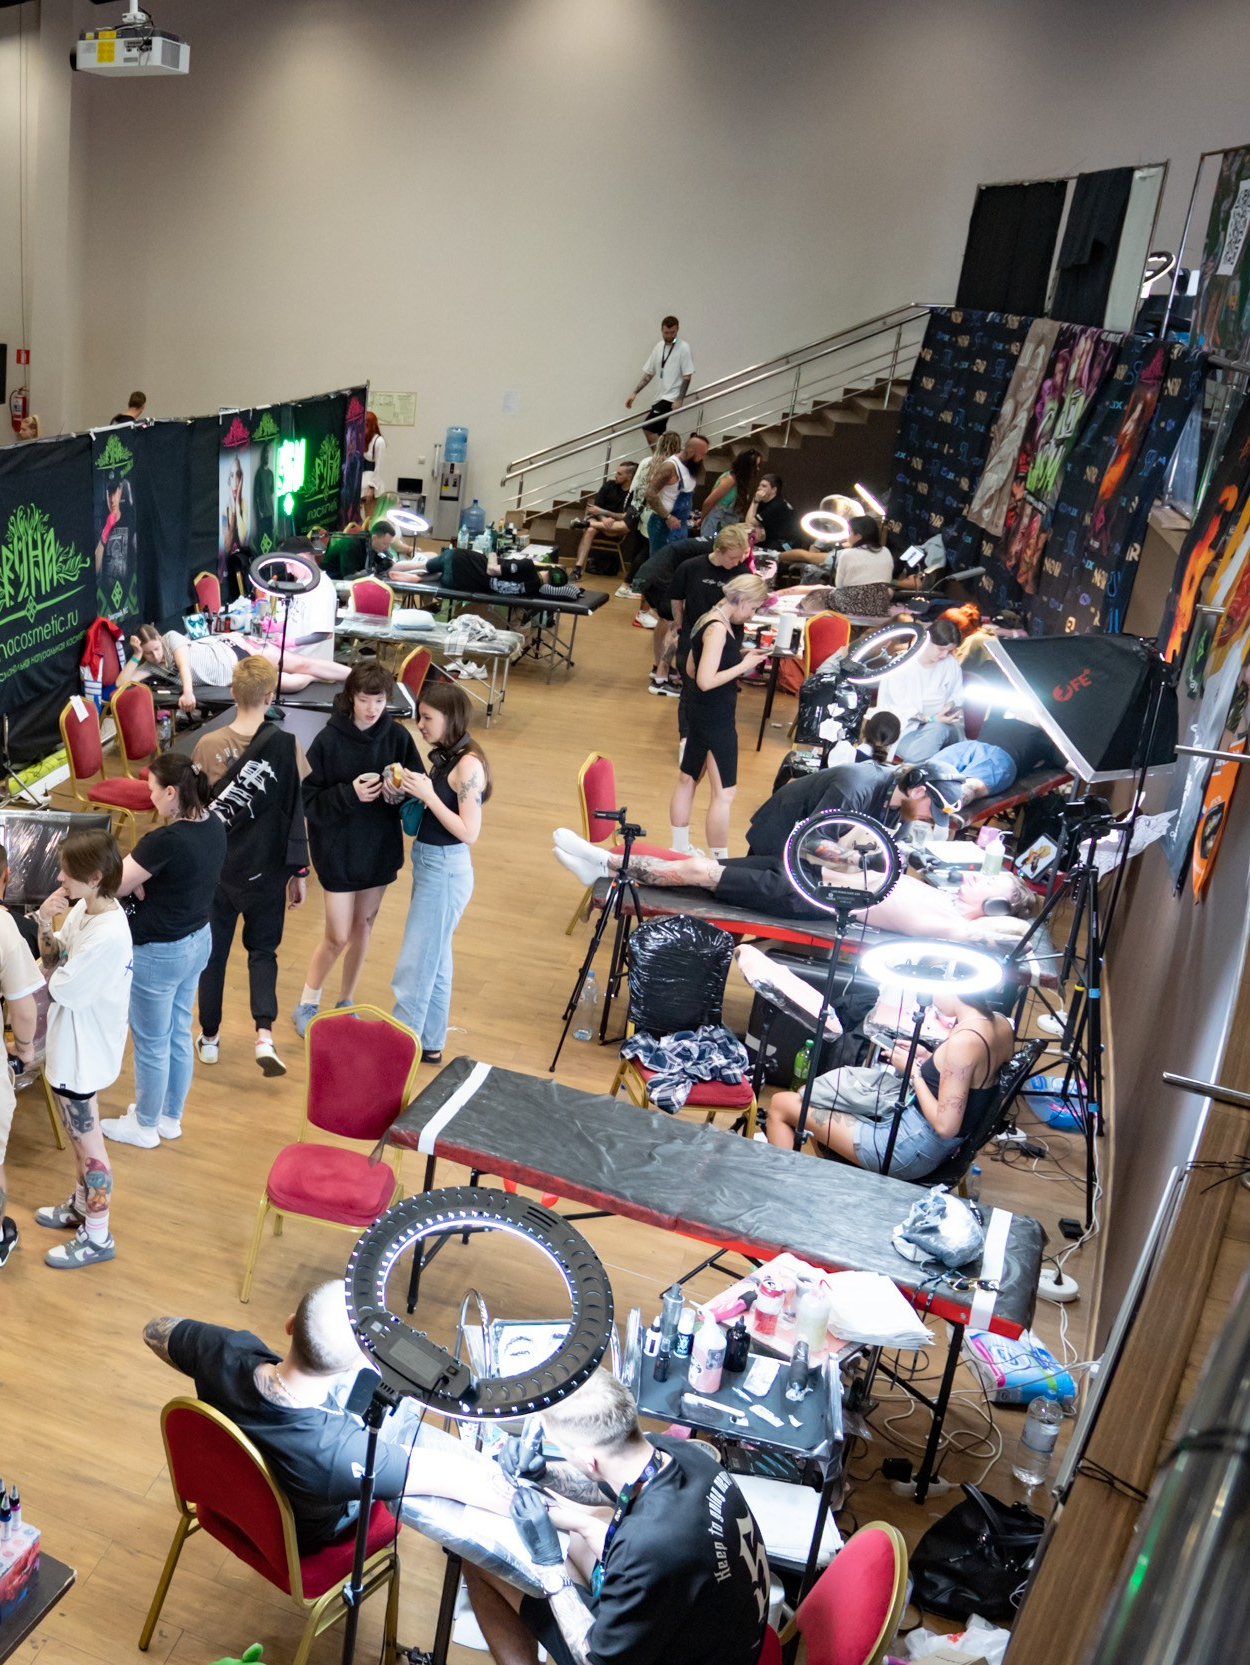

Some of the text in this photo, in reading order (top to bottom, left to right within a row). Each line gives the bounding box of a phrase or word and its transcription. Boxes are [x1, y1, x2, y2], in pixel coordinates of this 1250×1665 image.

[706, 1486, 726, 1523] going
[708, 1520, 724, 1538] to
[714, 1542, 732, 1583] Keep
